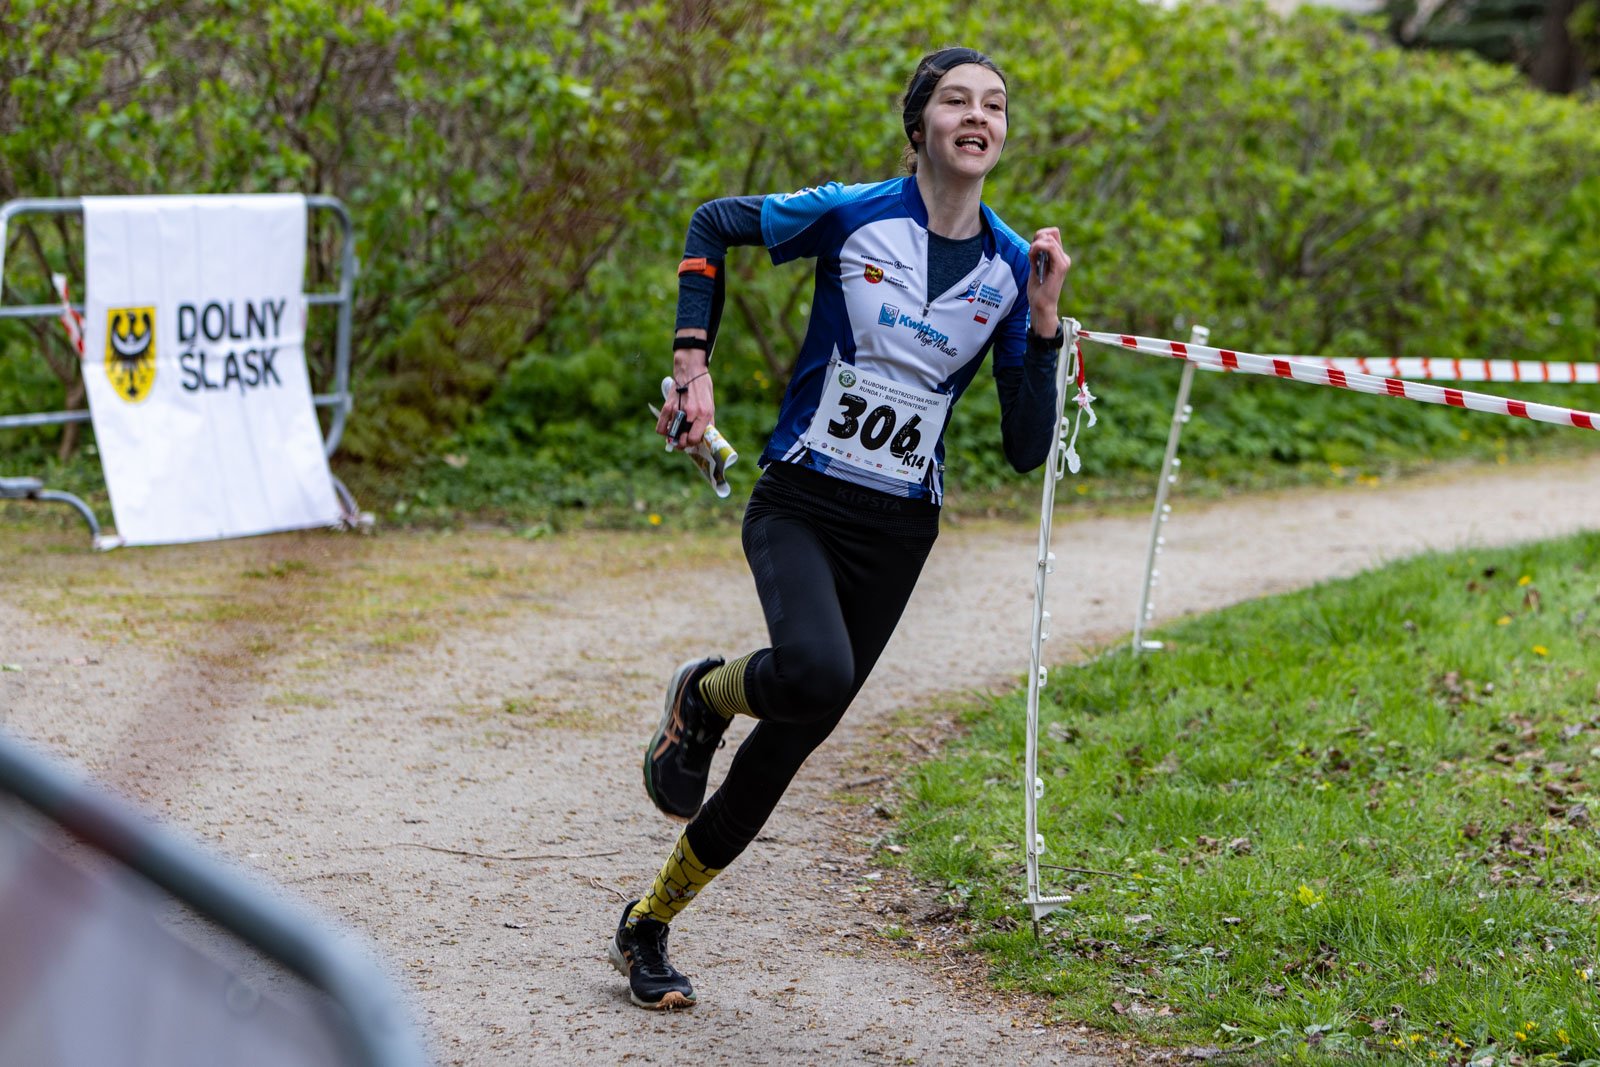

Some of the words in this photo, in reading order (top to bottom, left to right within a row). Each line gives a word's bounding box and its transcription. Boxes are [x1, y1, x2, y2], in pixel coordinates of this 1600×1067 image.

[177, 300, 286, 342] DOLNY
[898, 314, 949, 343] Kwidzyn
[913, 329, 933, 347] Moje
[933, 338, 958, 358] Miasto
[179, 342, 282, 395] ŚLĄSK
[859, 385, 879, 398] RUNDA
[884, 394, 897, 403] BIEG
[896, 398, 928, 411] SPRINTERSKI
[861, 378, 888, 392] KLUBOWE
[888, 387, 925, 403] MISTRZOSTWA
[924, 398, 940, 407] POLSKI
[827, 392, 922, 459] 306
[901, 451, 926, 470] K14
[836, 487, 902, 512] KIPSTA
